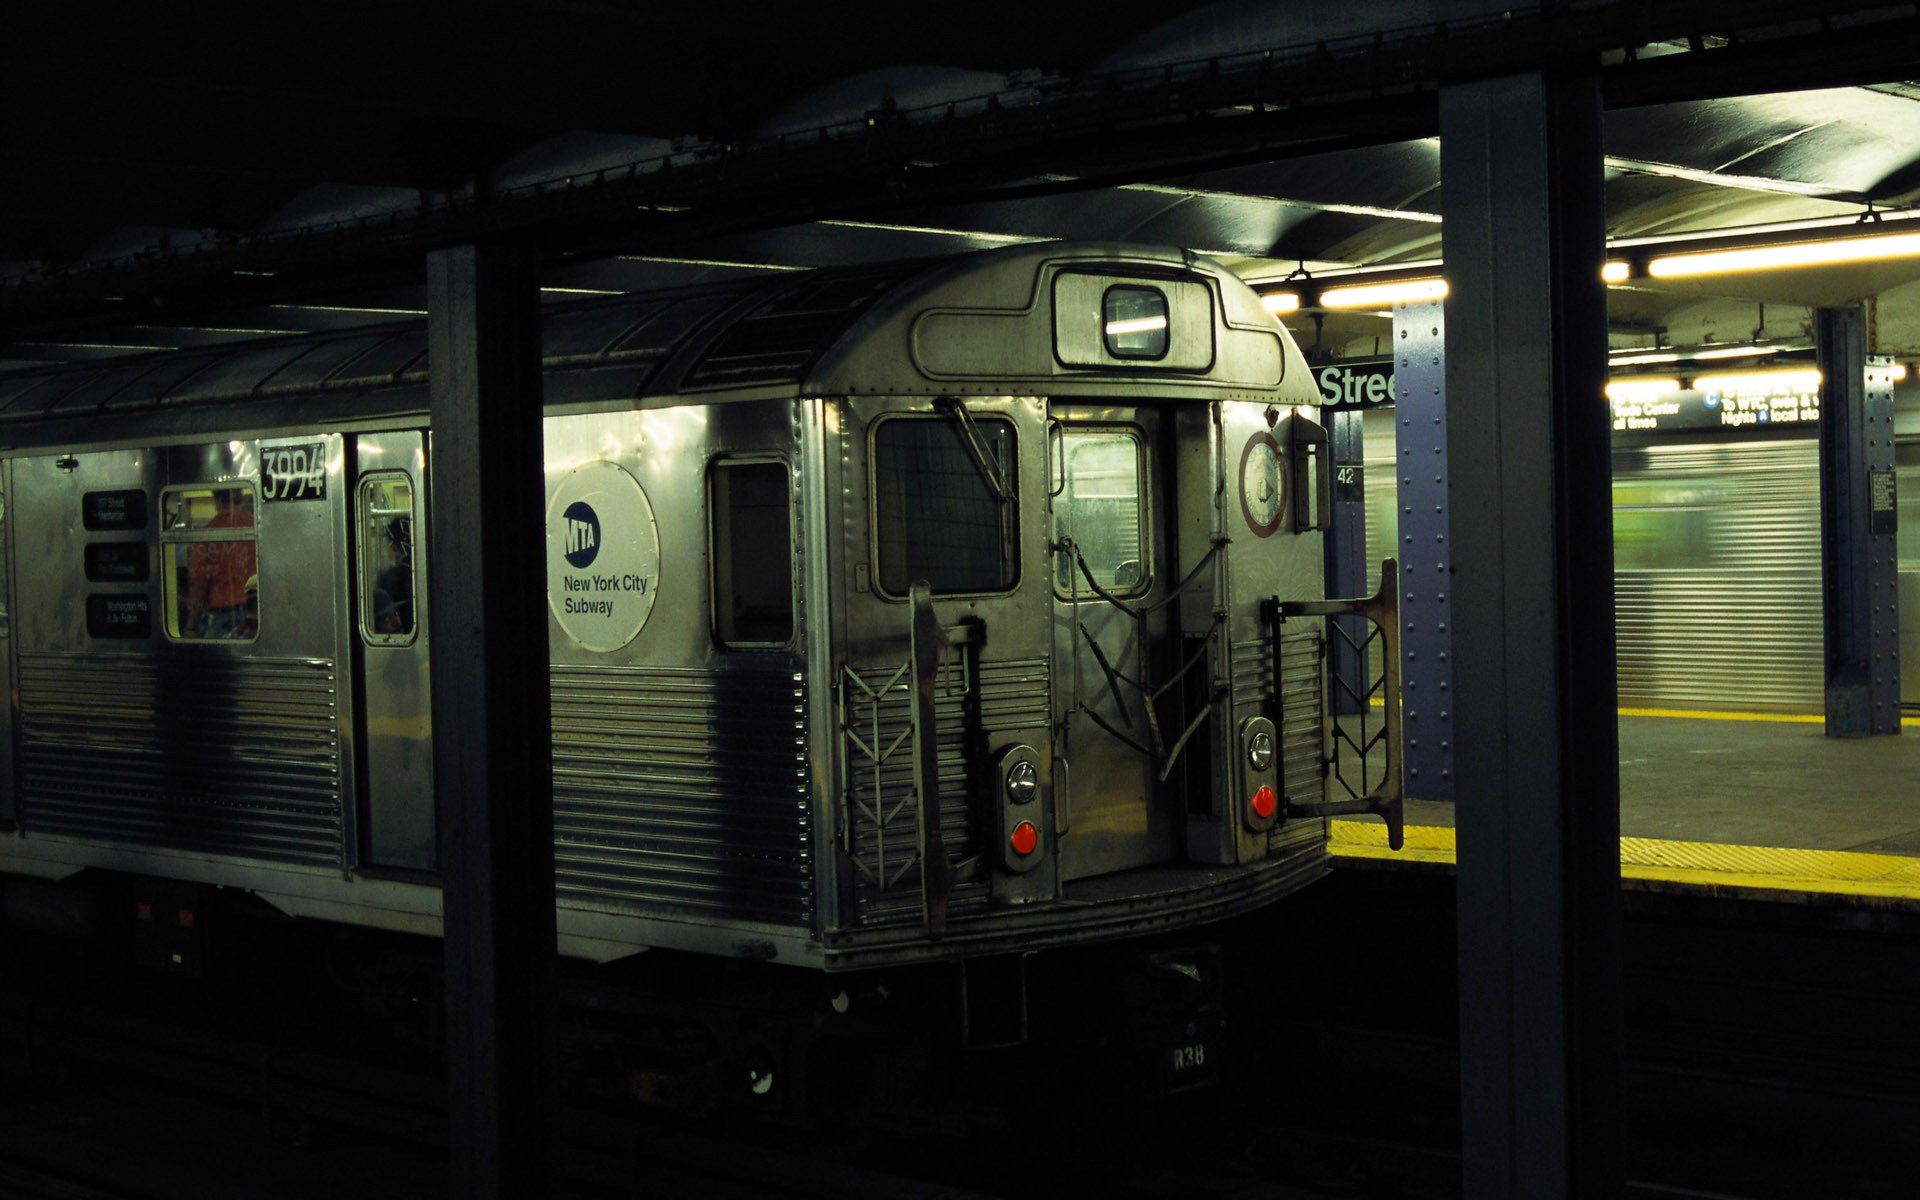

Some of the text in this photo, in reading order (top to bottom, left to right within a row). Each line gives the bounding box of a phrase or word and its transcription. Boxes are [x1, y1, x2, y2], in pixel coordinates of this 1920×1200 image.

[1643, 402, 1680, 416] Center
[1721, 398, 1735, 411] To
[1613, 416, 1657, 430] all times
[1721, 411, 1756, 427] Nights
[1759, 411, 1768, 421] A
[1771, 408, 1798, 421] local
[263, 443, 324, 499] 3994
[1337, 468, 1354, 484] 42
[563, 516, 595, 555] MTA
[564, 574, 648, 595] New York City
[564, 597, 613, 618] Subway
[1174, 1043, 1205, 1071] R38
